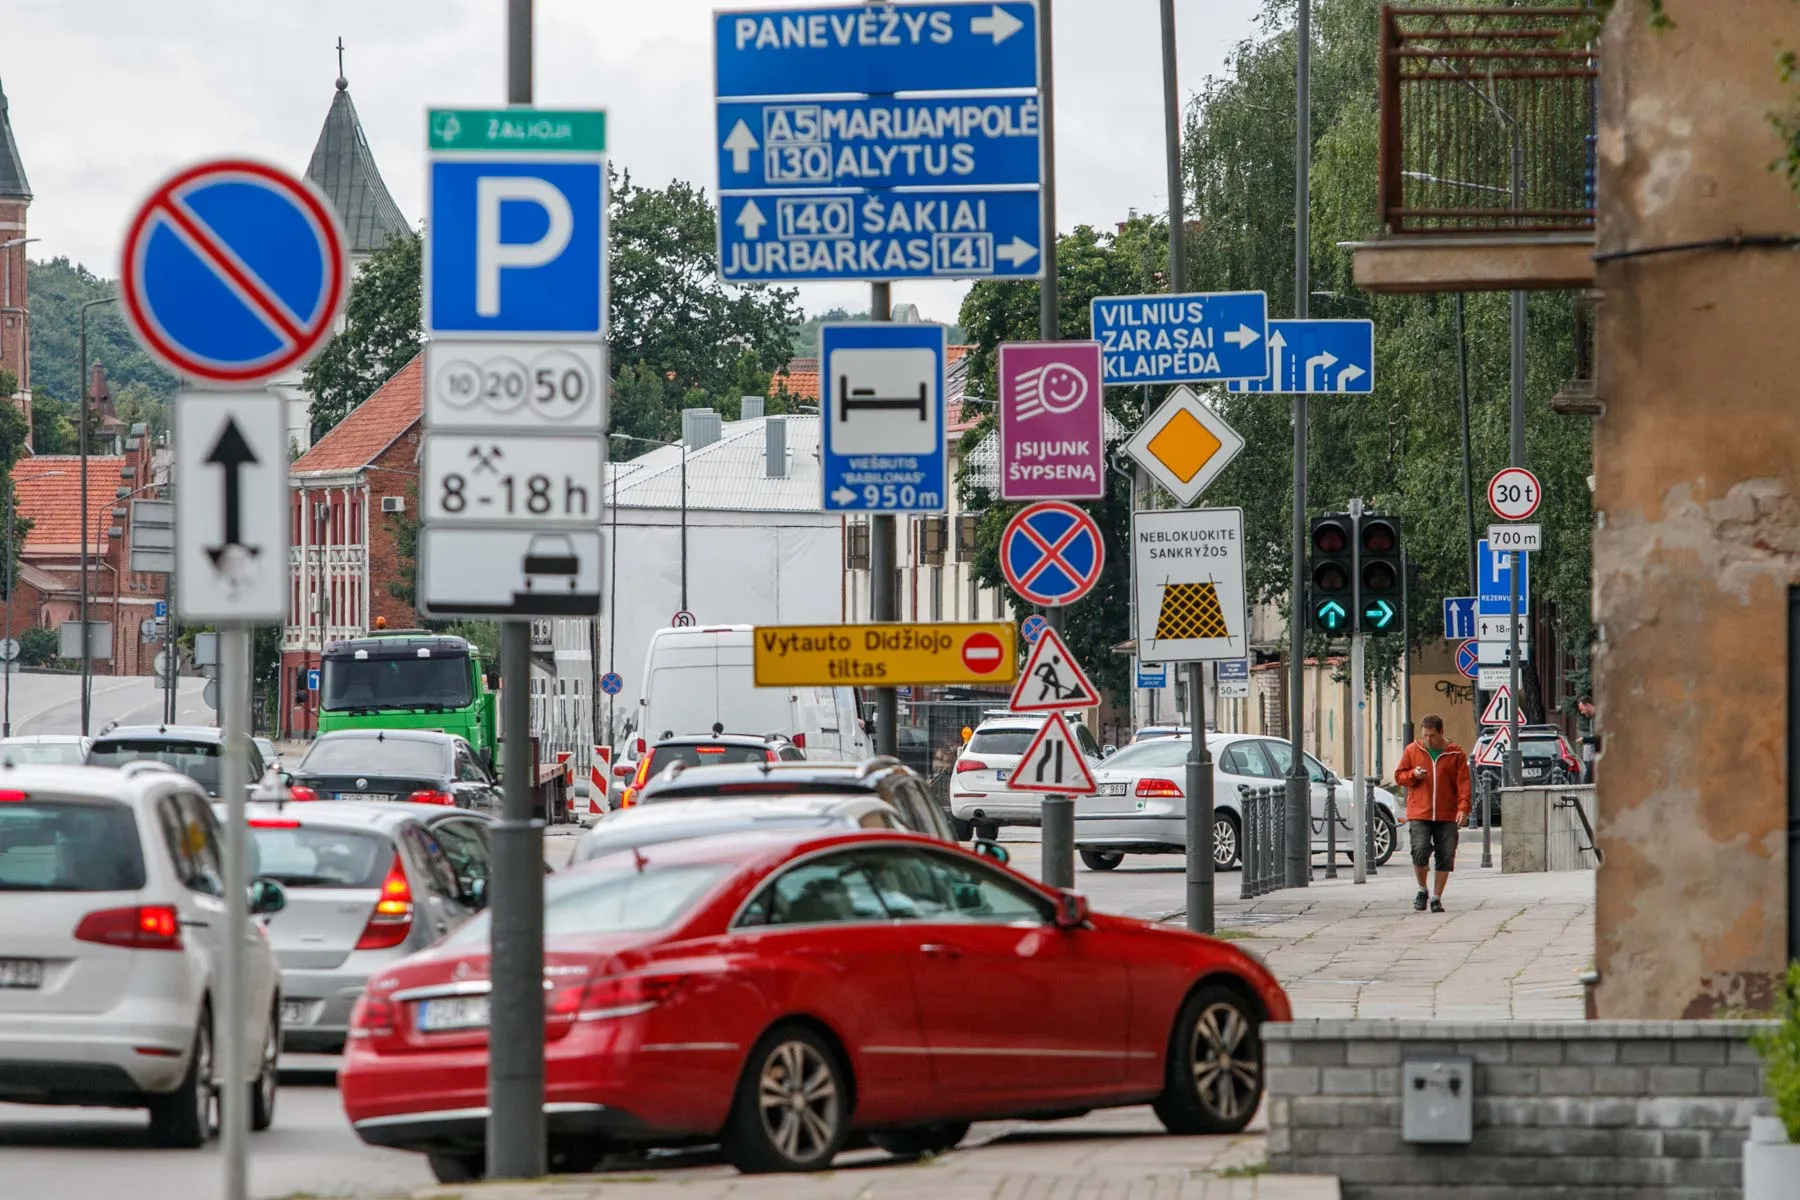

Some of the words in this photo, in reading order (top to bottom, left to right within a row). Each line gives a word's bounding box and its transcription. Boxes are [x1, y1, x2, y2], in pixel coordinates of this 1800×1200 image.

[735, 4, 953, 50] PANEVĖŽYS
[769, 109, 818, 141] A5
[823, 97, 1039, 140] MARIJAMPOLĖ
[767, 146, 830, 179] 130
[835, 142, 975, 178] ALYTUS
[782, 202, 848, 235] 140
[862, 195, 987, 233] ŠAKIAI
[475, 175, 575, 318] P
[724, 239, 930, 276] JURBARKAS
[936, 238, 990, 269] 141
[1101, 302, 1204, 326] VILNIUS
[1102, 327, 1214, 352] ZARASAI
[1103, 348, 1221, 378] KLAIPĖDA
[484, 371, 523, 399] 20
[535, 368, 584, 404] 50
[1015, 441, 1090, 460] ĮSIJUNK
[1009, 462, 1096, 482] ŠYPSENĄ
[1140, 529, 1236, 543] NEBLOKUOKITE
[1150, 543, 1228, 559] SANKRYŽOS
[763, 632, 851, 656] Vytauto
[864, 629, 953, 655] Didžiojo
[828, 659, 887, 679] tiltas
